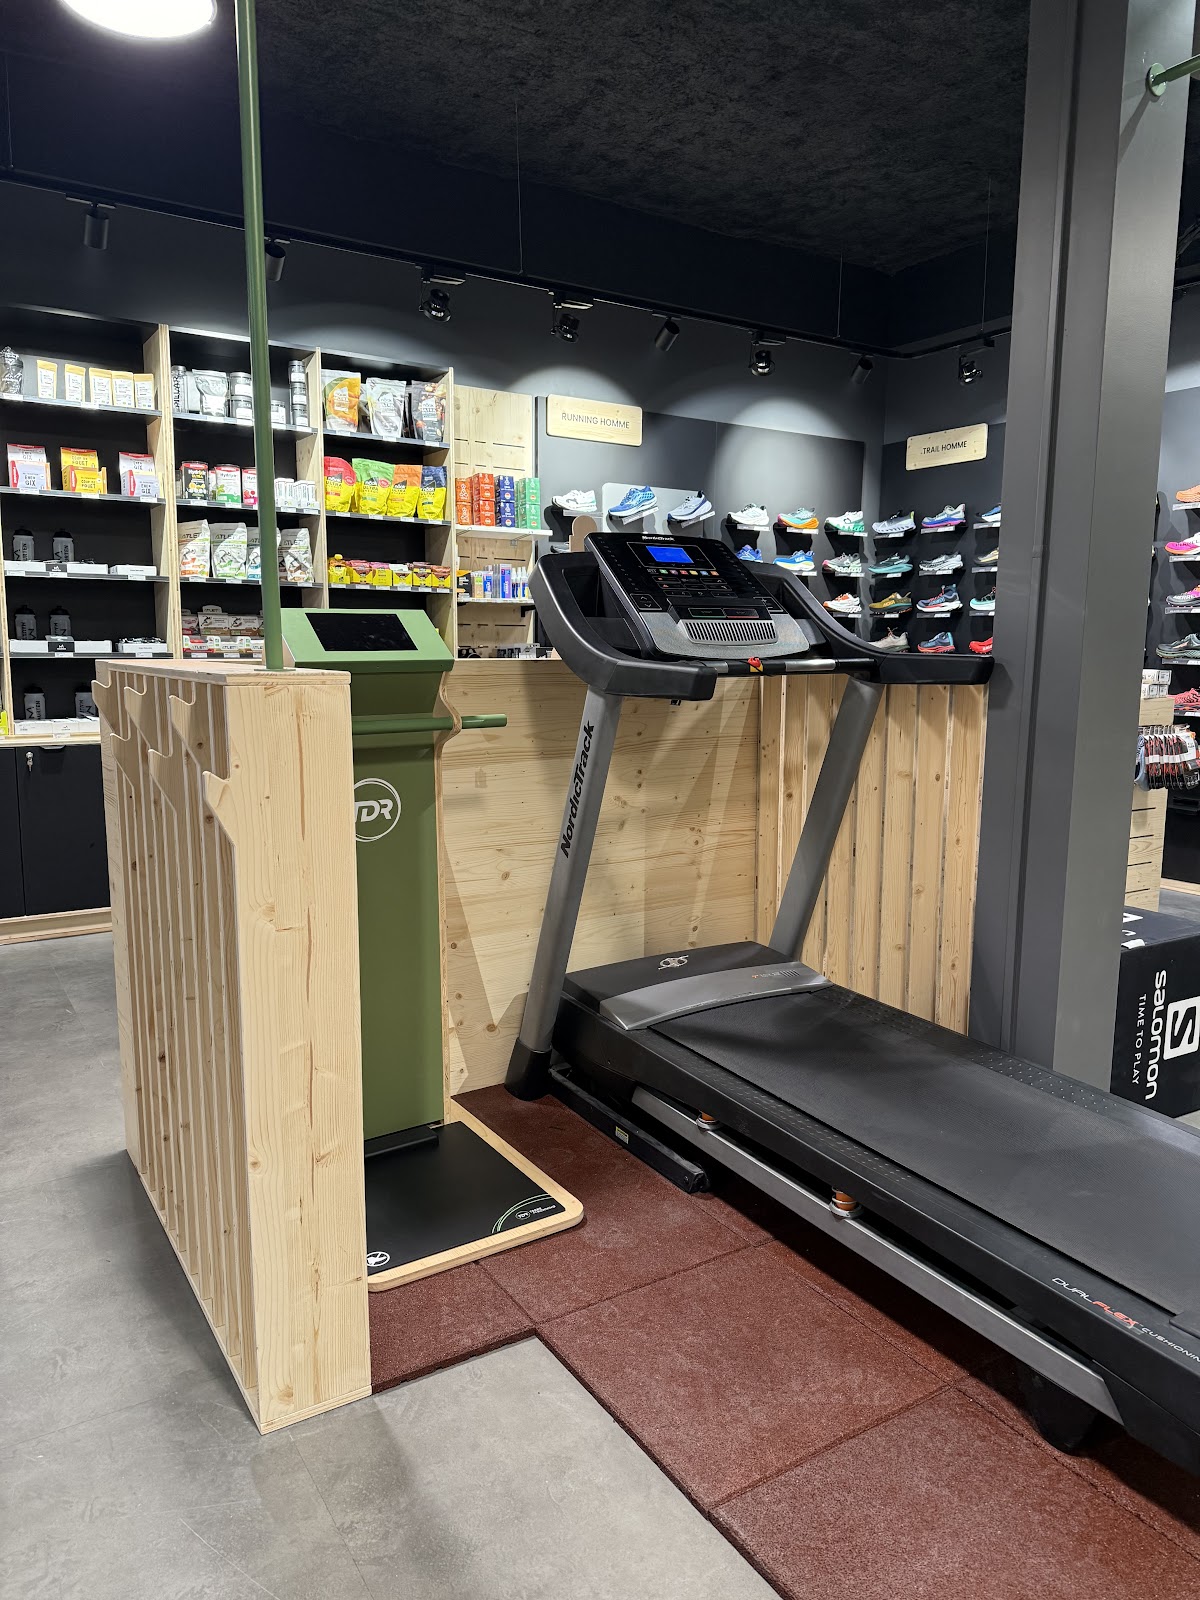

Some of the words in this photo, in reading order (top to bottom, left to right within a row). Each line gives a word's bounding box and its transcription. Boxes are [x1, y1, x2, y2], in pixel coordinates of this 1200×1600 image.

[561, 412, 599, 425] RUNNING
[600, 418, 630, 429] HOMME
[922, 446, 940, 455] TRAIL
[941, 440, 968, 452] HOMME
[560, 720, 595, 859] NordicTrack
[1136, 993, 1147, 1028] TIME
[1135, 1029, 1144, 1049] TO
[1132, 1052, 1142, 1085] PLAY
